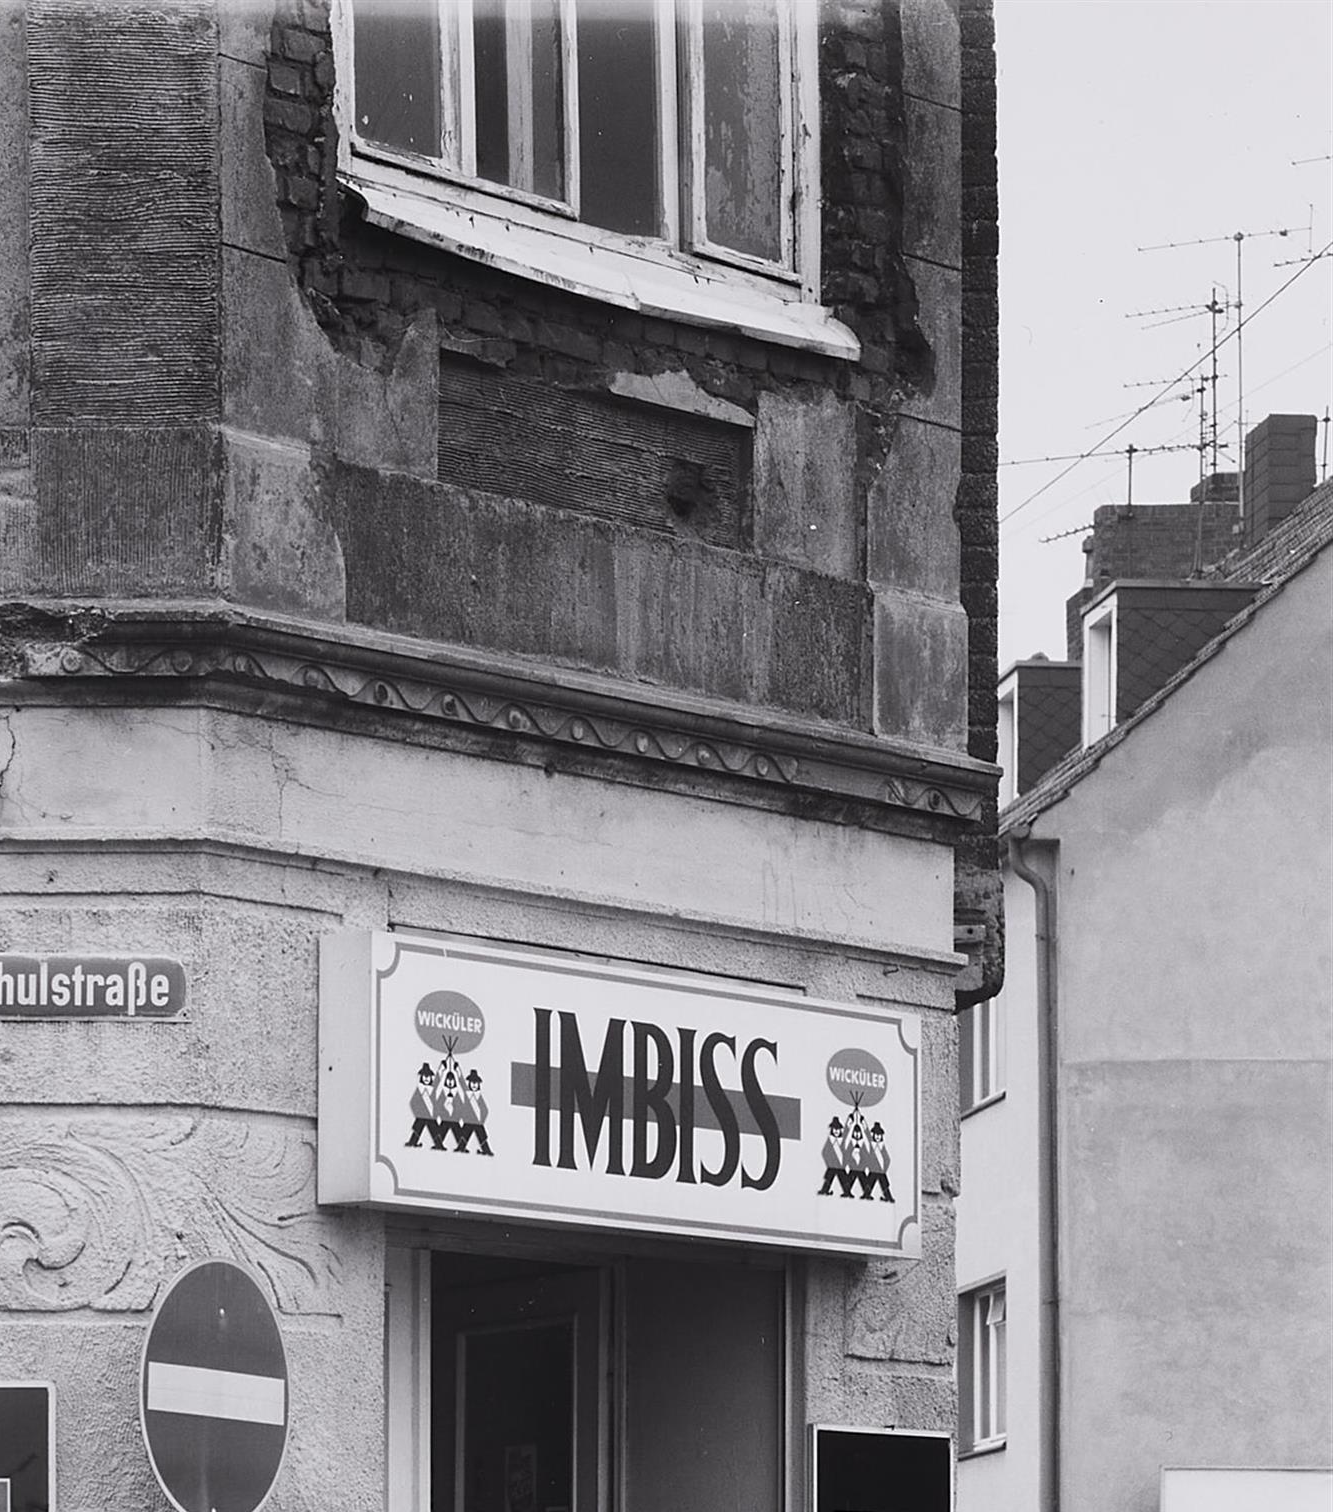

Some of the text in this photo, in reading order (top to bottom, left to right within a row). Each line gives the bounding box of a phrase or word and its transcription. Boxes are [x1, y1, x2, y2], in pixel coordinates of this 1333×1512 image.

[417, 1010, 483, 1035] WICKÜLER
[829, 1064, 886, 1091] WICKÜLER
[533, 1007, 779, 1190] IMBISS
